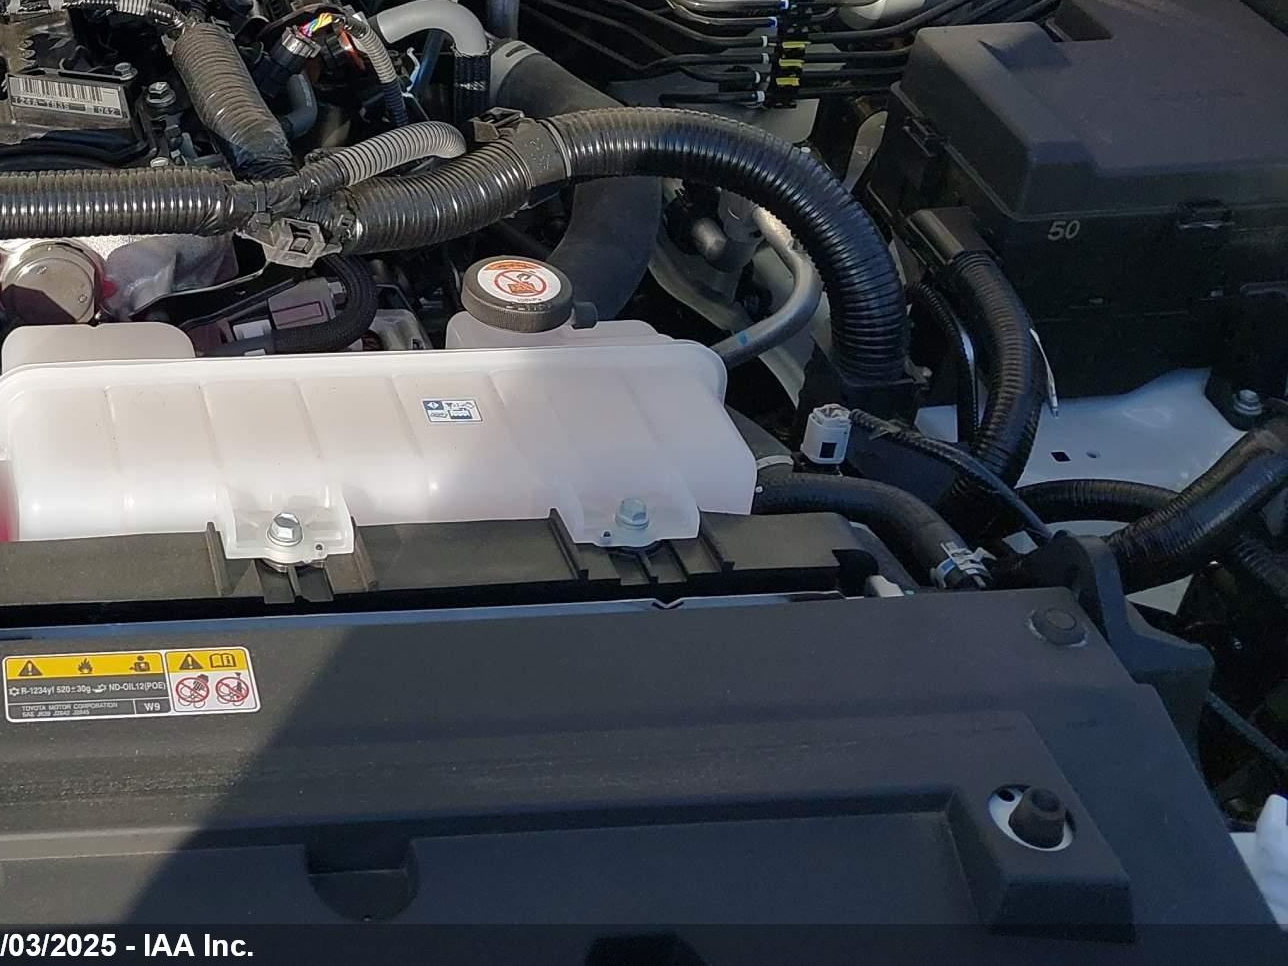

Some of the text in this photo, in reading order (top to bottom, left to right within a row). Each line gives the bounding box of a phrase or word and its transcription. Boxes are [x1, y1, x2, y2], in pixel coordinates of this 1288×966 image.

[1047, 220, 1081, 241] 50
[21, 686, 55, 695] R-1234yf
[108, 681, 166, 692] ND-OIL12(POE)
[143, 702, 161, 711] W9
